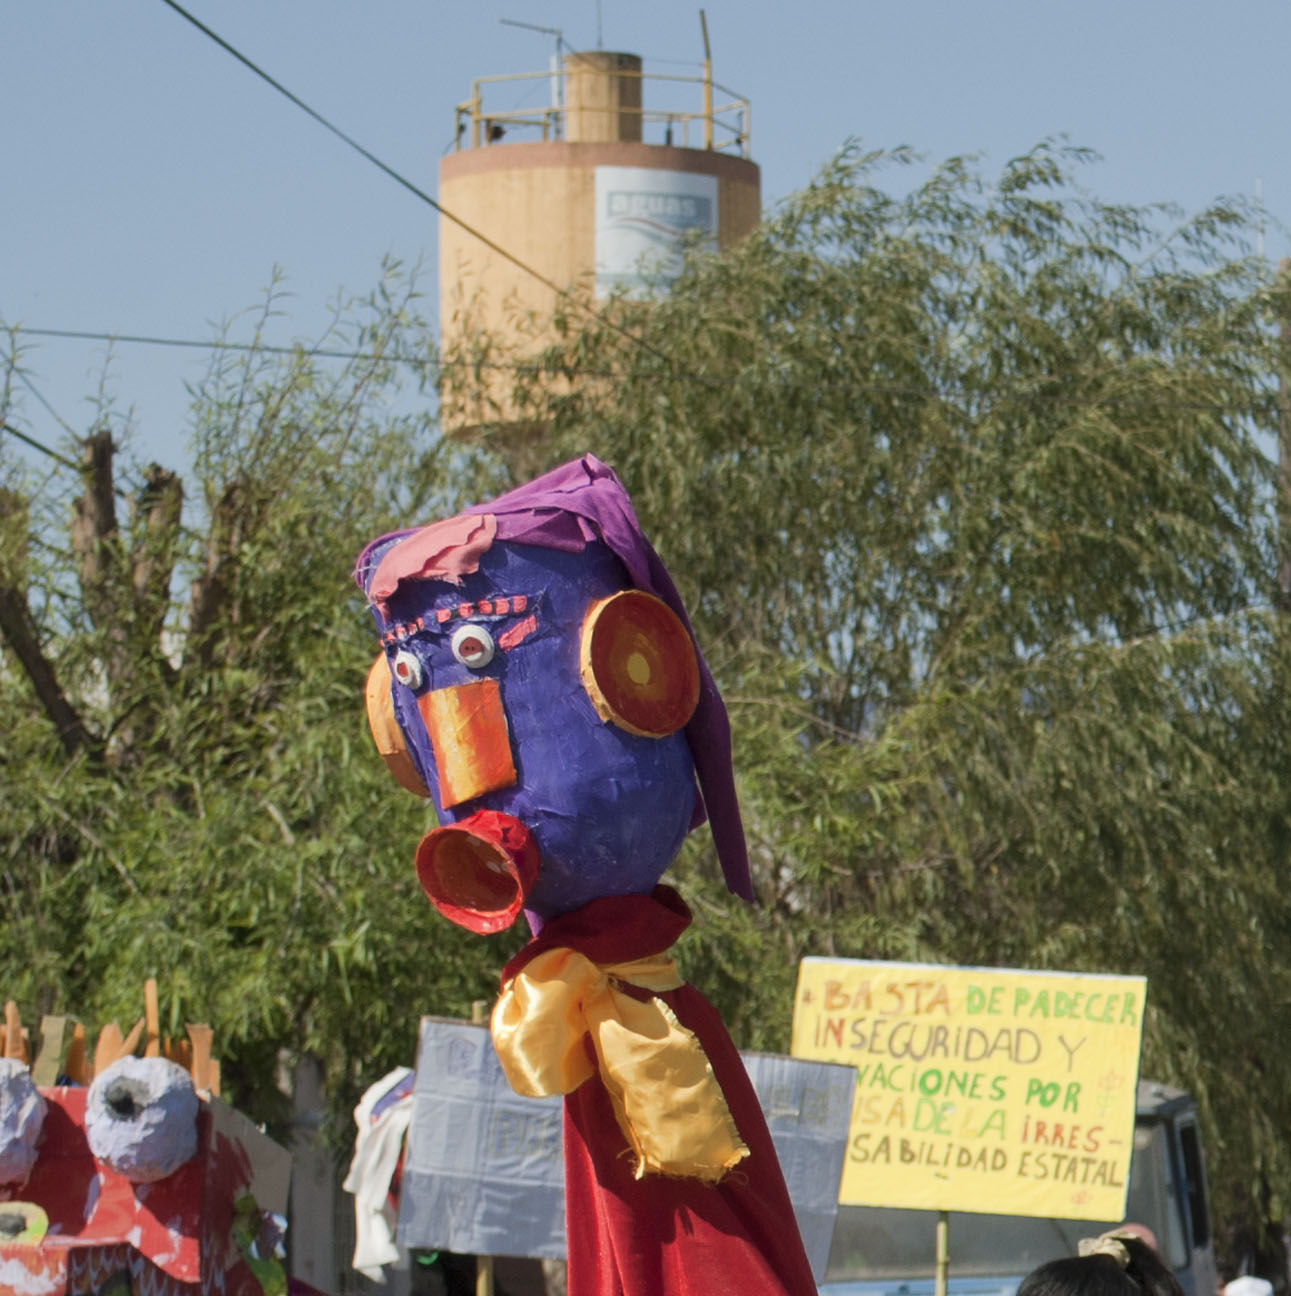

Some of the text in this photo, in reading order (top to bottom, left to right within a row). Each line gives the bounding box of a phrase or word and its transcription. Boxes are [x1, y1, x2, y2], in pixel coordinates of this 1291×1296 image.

[611, 194, 696, 217] aguas
[824, 980, 1137, 1027] BASTA DE PADECER
[814, 1015, 1087, 1073] INSEGURIDAD Y
[1025, 1077, 1081, 1114] POR
[912, 1097, 953, 1137] DE
[960, 1106, 1007, 1140] LA
[1018, 1151, 1124, 1189] ESTATAL
